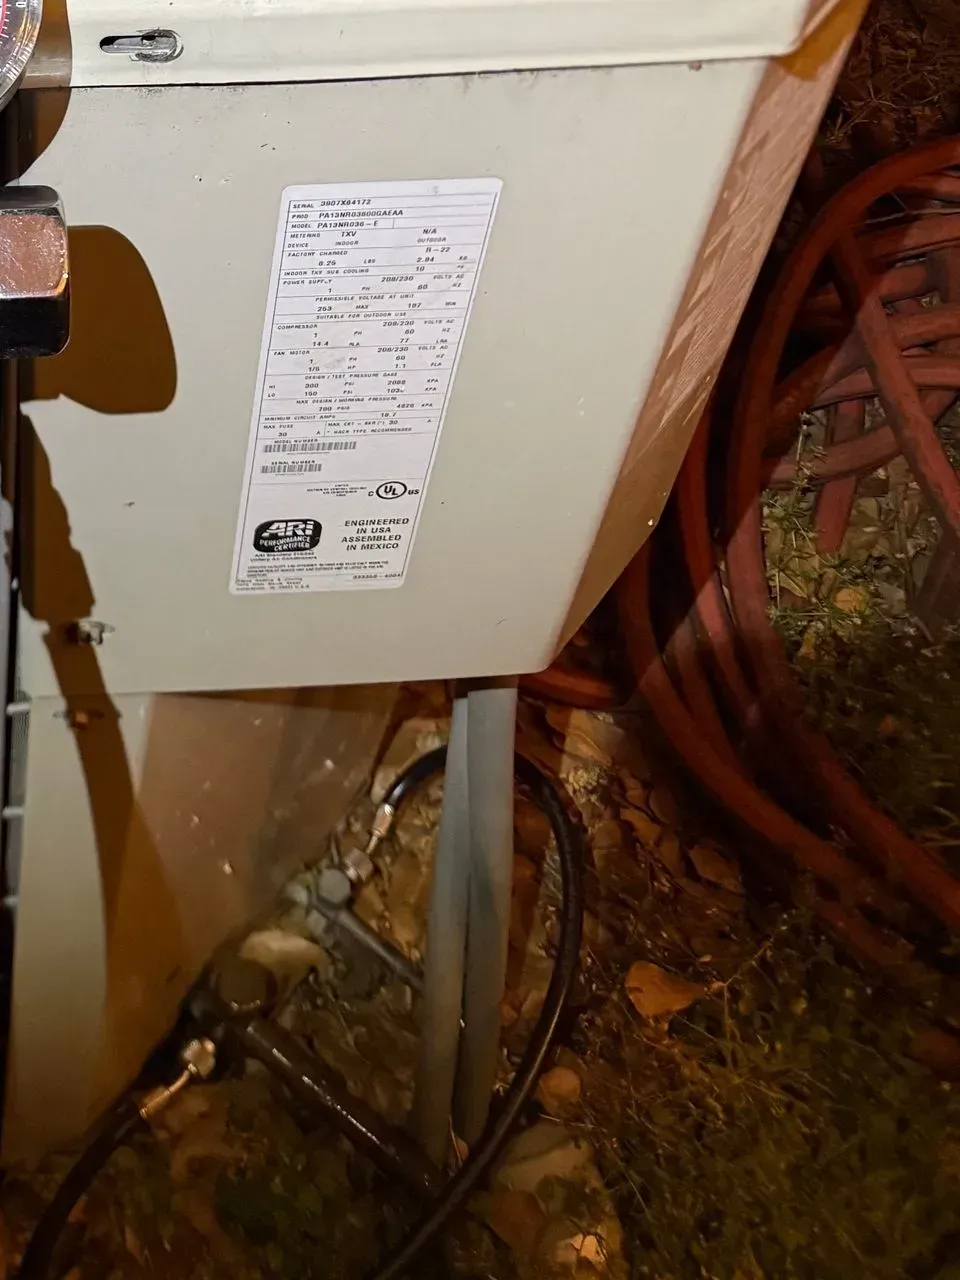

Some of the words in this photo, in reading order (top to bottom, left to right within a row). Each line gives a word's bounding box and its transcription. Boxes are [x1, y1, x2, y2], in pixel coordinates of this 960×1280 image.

[384, 485, 399, 496] UL
[408, 488, 420, 496] US
[344, 517, 409, 527] ENGINEERED
[370, 526, 392, 534] USA
[259, 536, 311, 547] PERFORMANCE
[341, 534, 402, 543] ASSEMBLED
[360, 542, 399, 550] MEXICO
